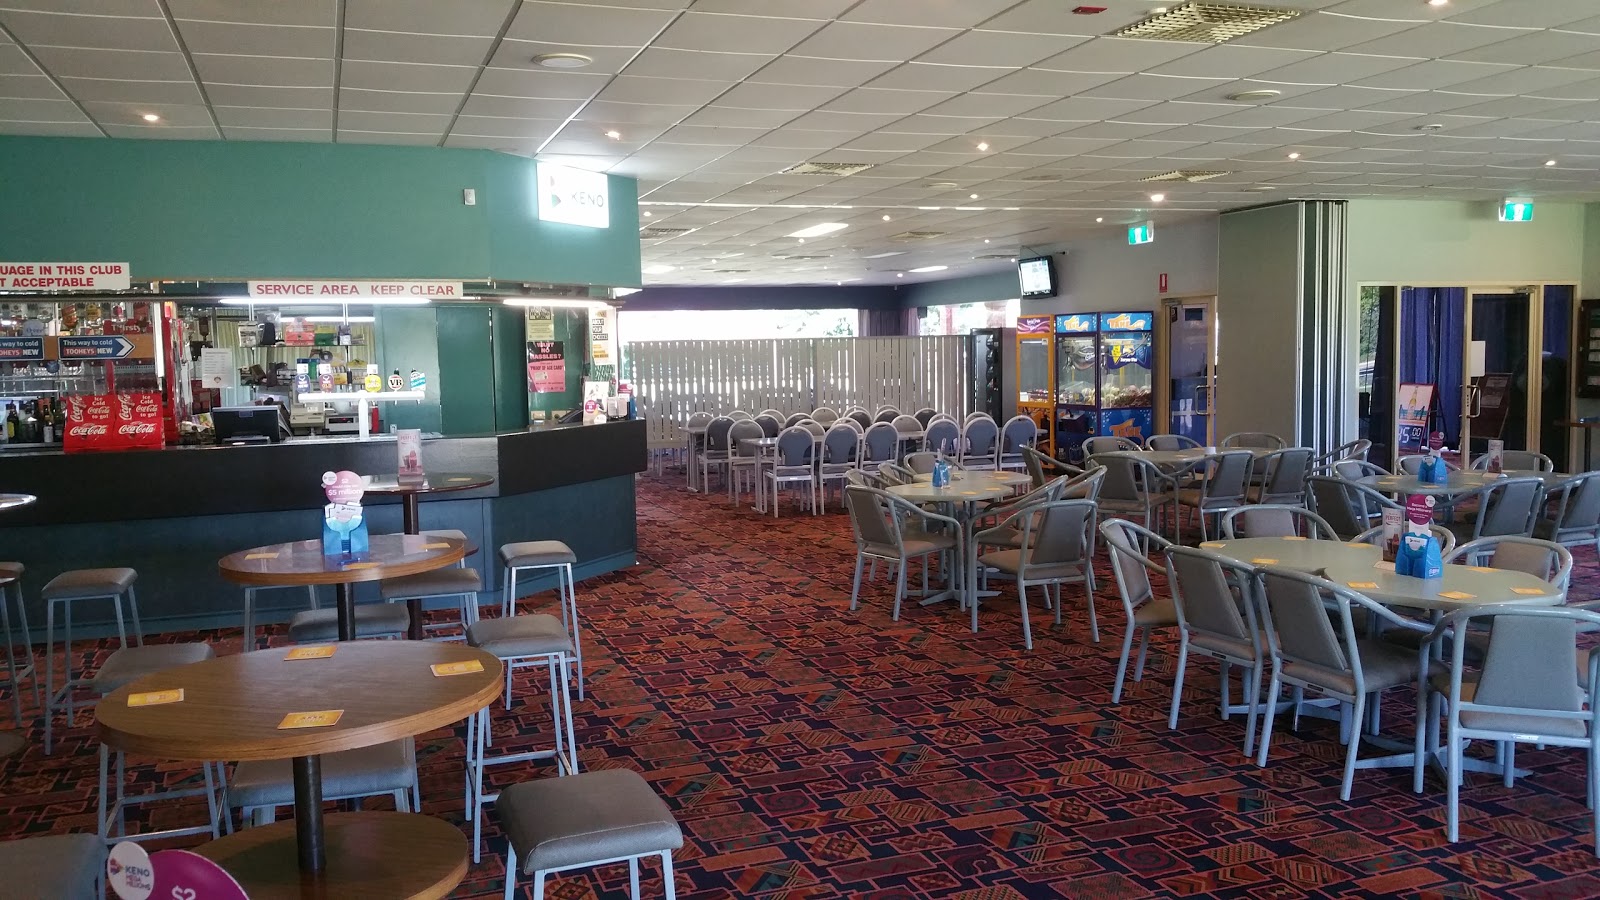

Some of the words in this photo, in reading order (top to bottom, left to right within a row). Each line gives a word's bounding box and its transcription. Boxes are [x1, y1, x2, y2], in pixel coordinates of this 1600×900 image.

[571, 191, 604, 208] KENO
[39, 265, 52, 275] IN
[56, 265, 85, 275] THIS
[89, 265, 122, 275] CLUB
[12, 277, 95, 288] ACCEPTABLE
[256, 284, 314, 295] SERVICE
[320, 285, 360, 295] AREA
[371, 285, 405, 295] KEEP
[410, 285, 455, 296] CLEAR
[22, 348, 39, 356] NEW
[65, 347, 95, 355] TOOHEYS
[97, 347, 113, 355] NEW
[390, 379, 402, 387] VB
[1385, 514, 1401, 522] PERFECT
[125, 864, 150, 877] KENO
[171, 885, 197, 900] $2
